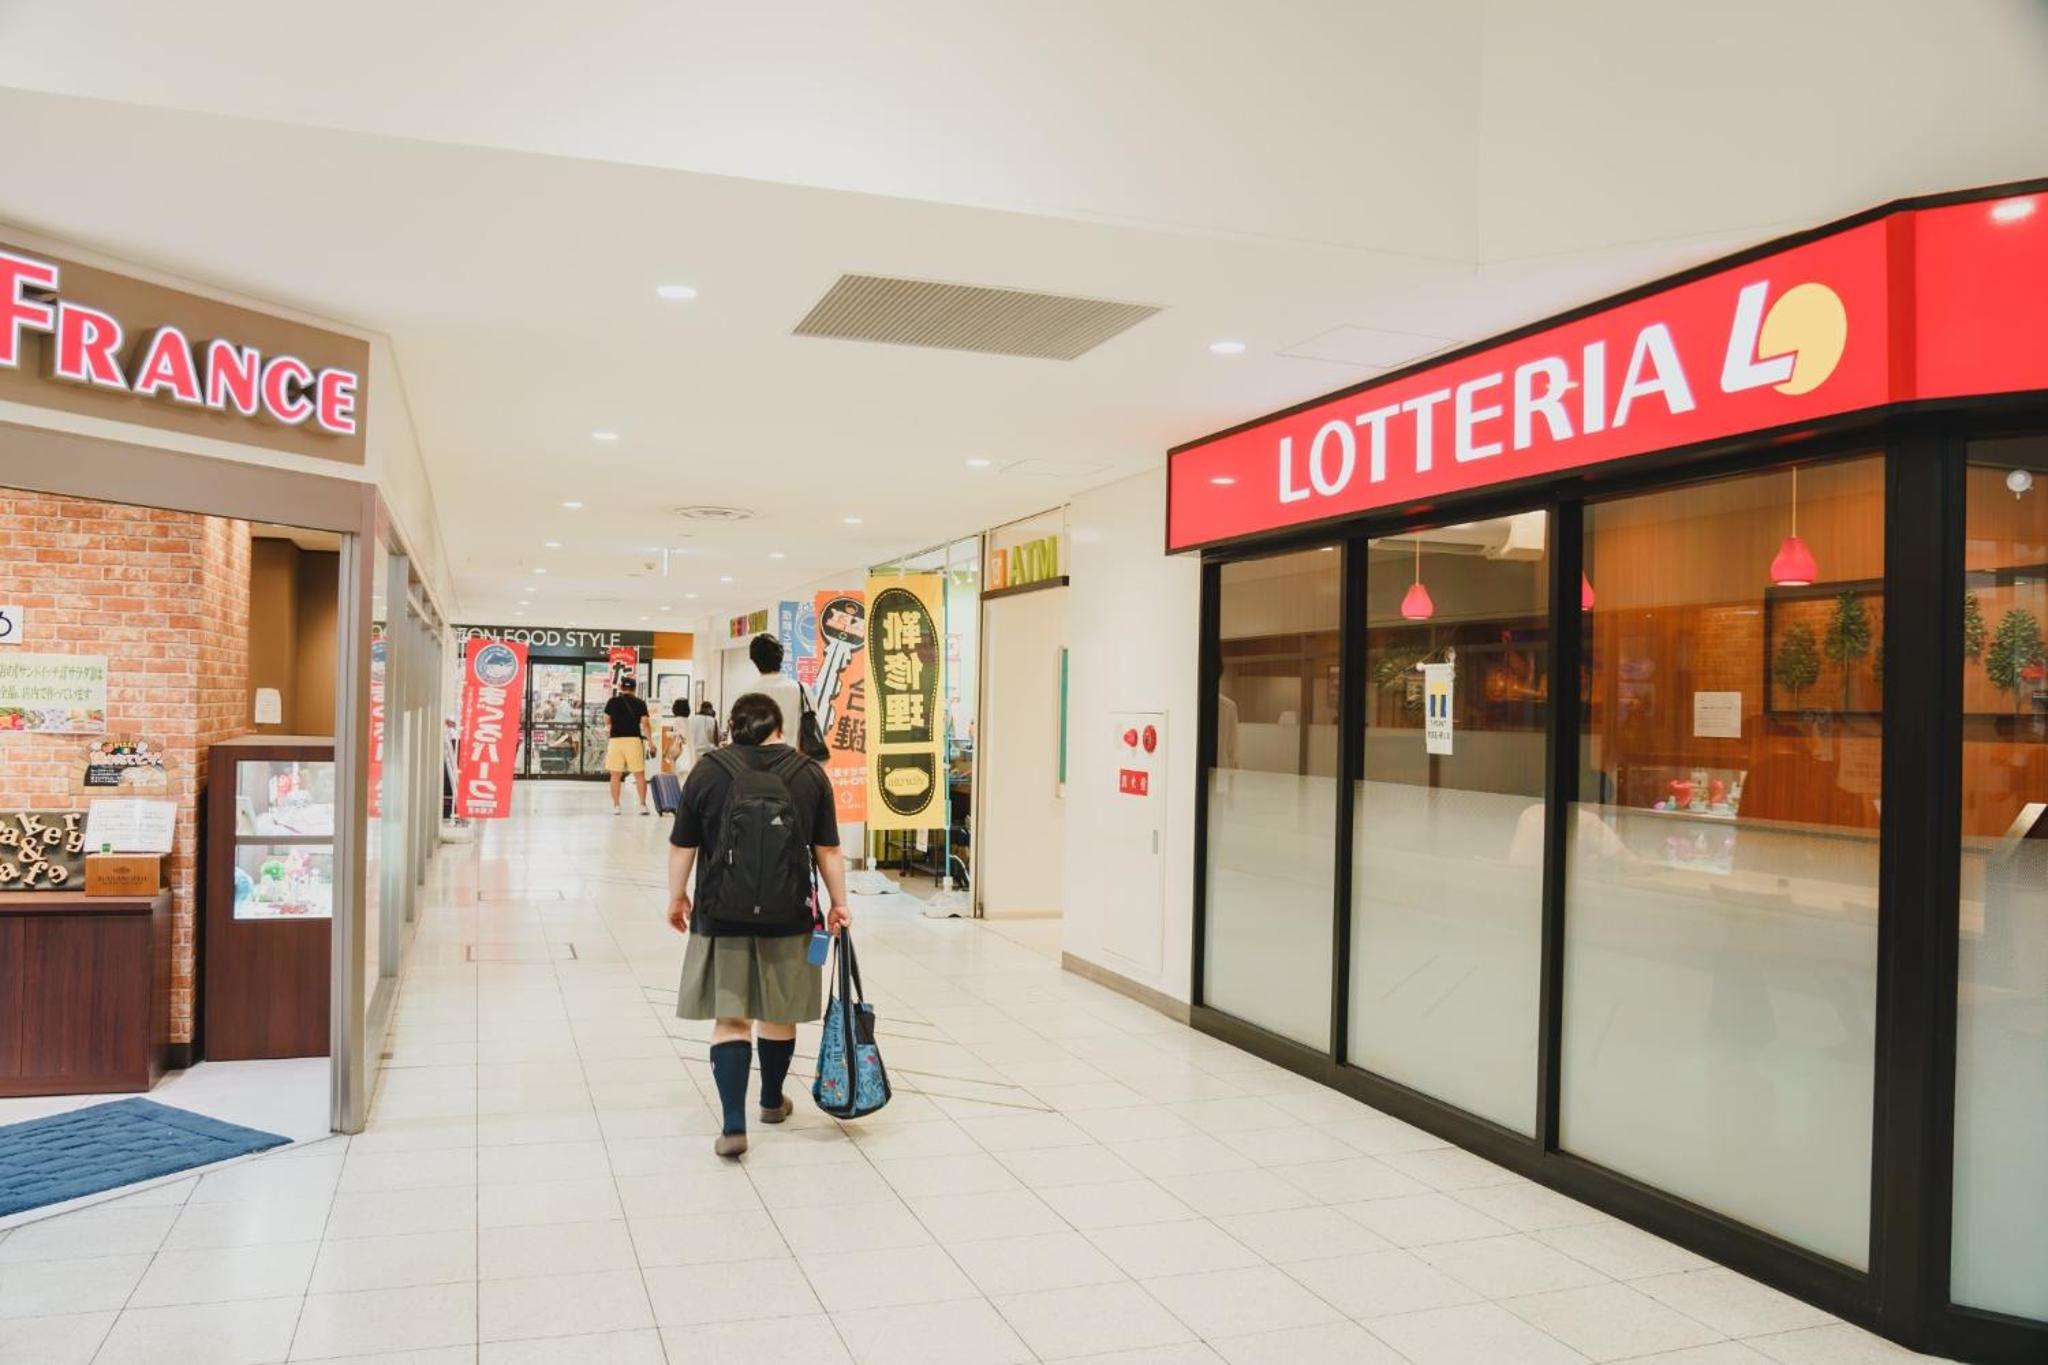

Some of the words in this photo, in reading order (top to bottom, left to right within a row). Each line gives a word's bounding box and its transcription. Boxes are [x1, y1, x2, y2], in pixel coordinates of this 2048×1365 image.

[0, 253, 357, 434] FRANCE
[1278, 322, 1697, 505] LOTTERIA
[1010, 535, 1058, 587] ATM
[504, 630, 561, 647] FOOD
[566, 632, 621, 647] STYLE
[0, 812, 86, 853] akery
[0, 861, 68, 885] afe
